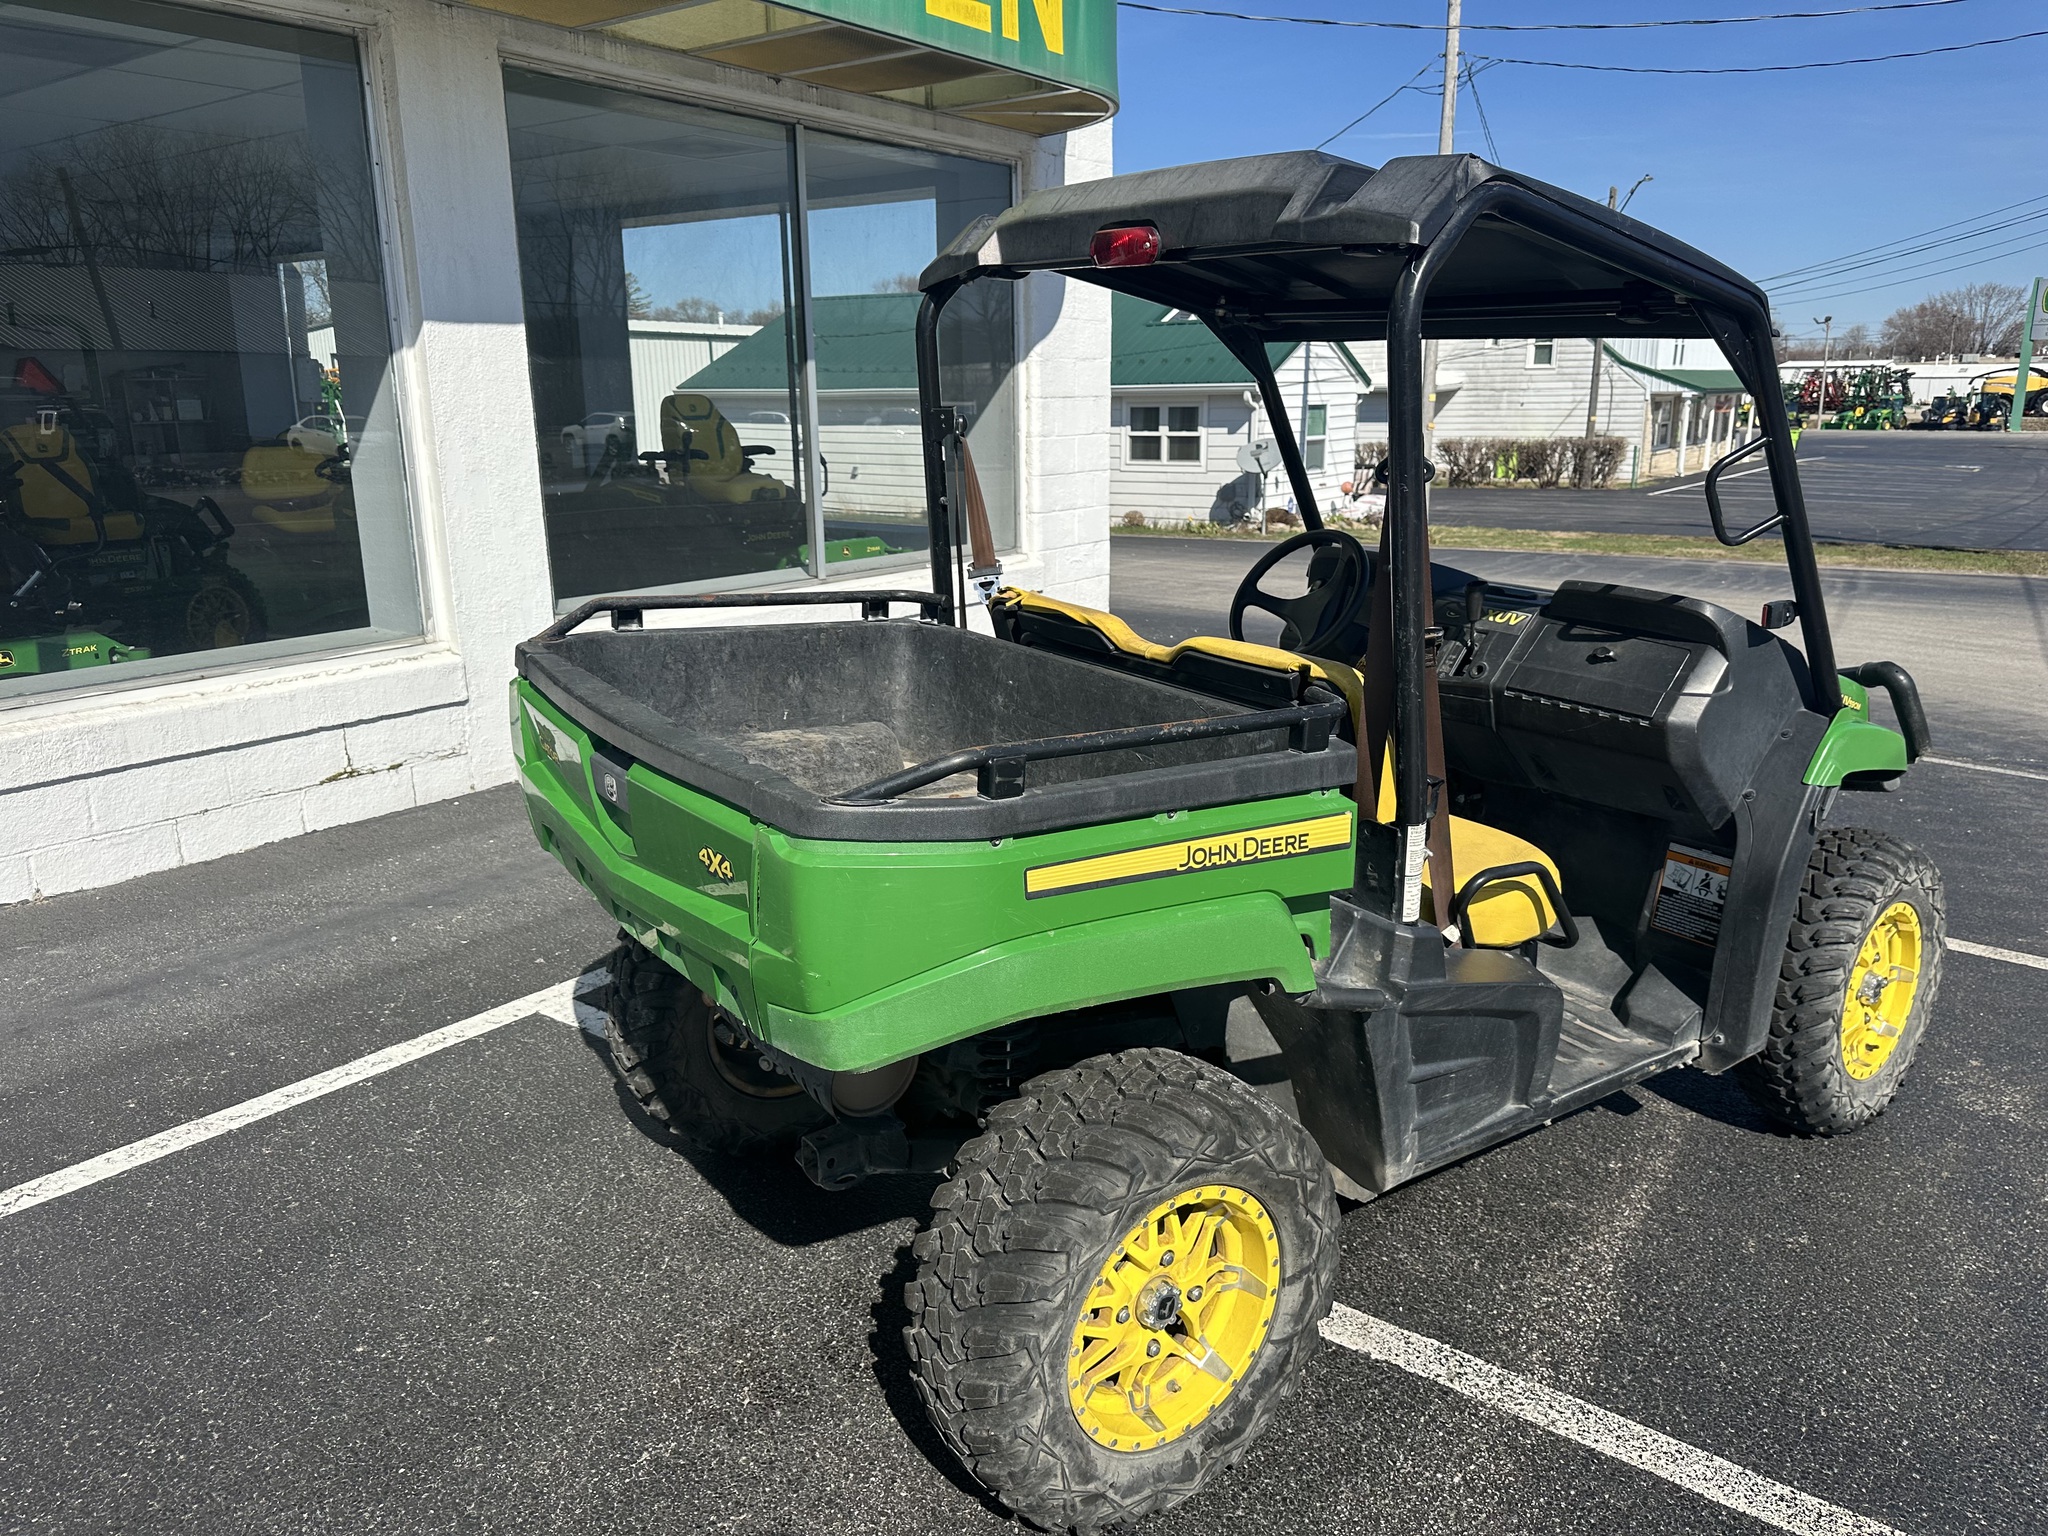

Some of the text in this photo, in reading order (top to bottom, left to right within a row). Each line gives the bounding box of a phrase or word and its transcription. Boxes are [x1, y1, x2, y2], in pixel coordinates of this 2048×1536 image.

[1482, 610, 1527, 626] XUV
[61, 644, 97, 657] ZTRAK
[1178, 832, 1310, 868] JOHN DEERE
